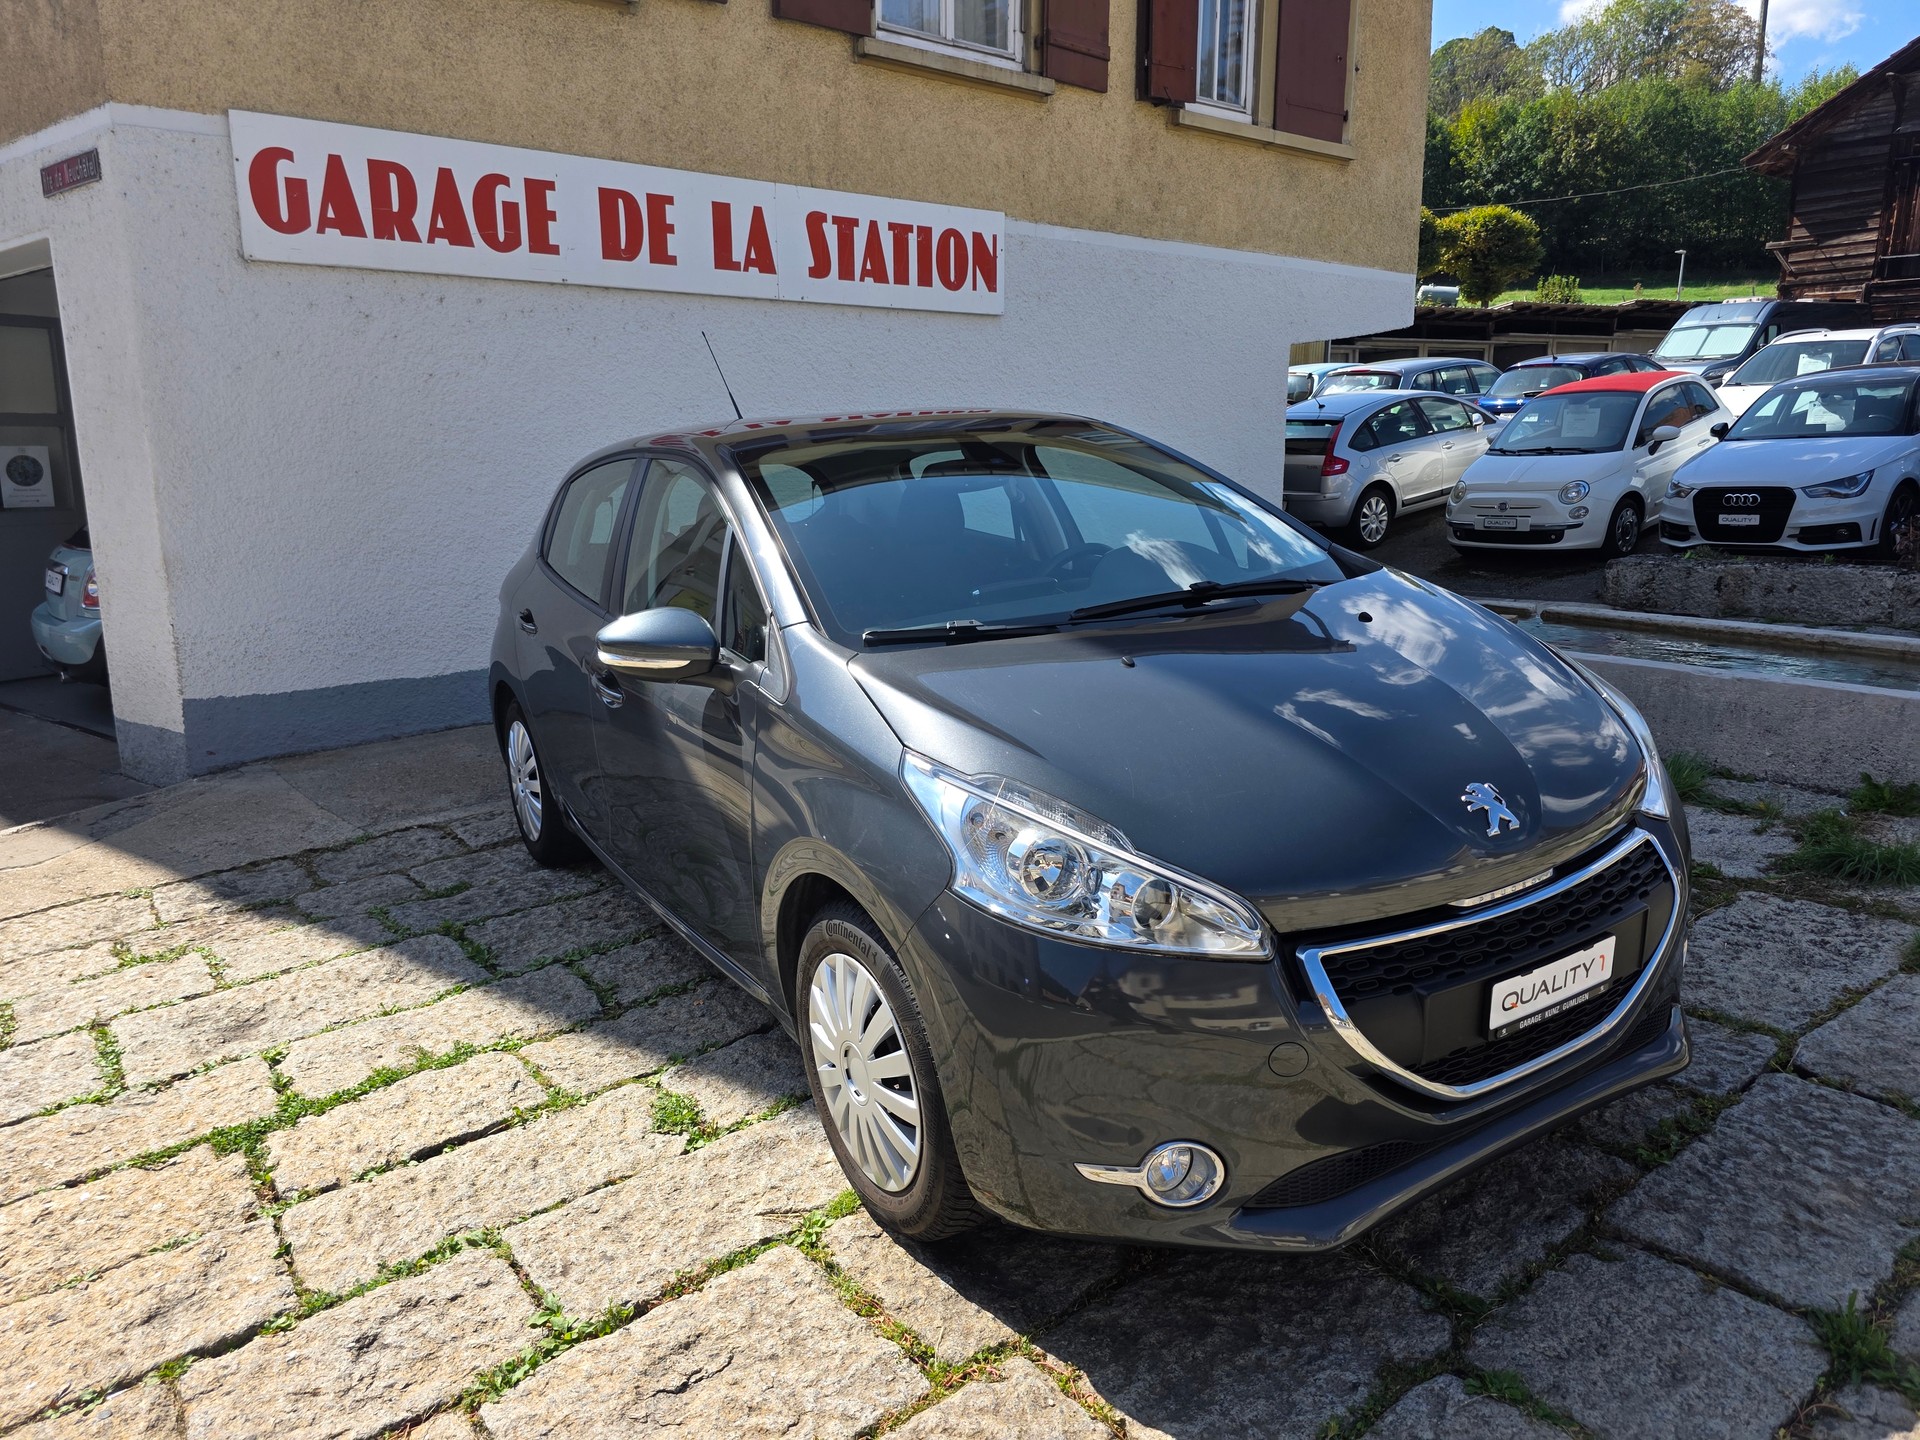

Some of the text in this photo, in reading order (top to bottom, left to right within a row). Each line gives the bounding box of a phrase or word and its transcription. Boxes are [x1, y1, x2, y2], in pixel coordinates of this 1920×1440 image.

[248, 147, 998, 293] GARAGE DE LA STATION
[826, 919, 872, 958] Continental
[1519, 1013, 1542, 1029] GARAGE
[1544, 1005, 1560, 1018] KUNZ
